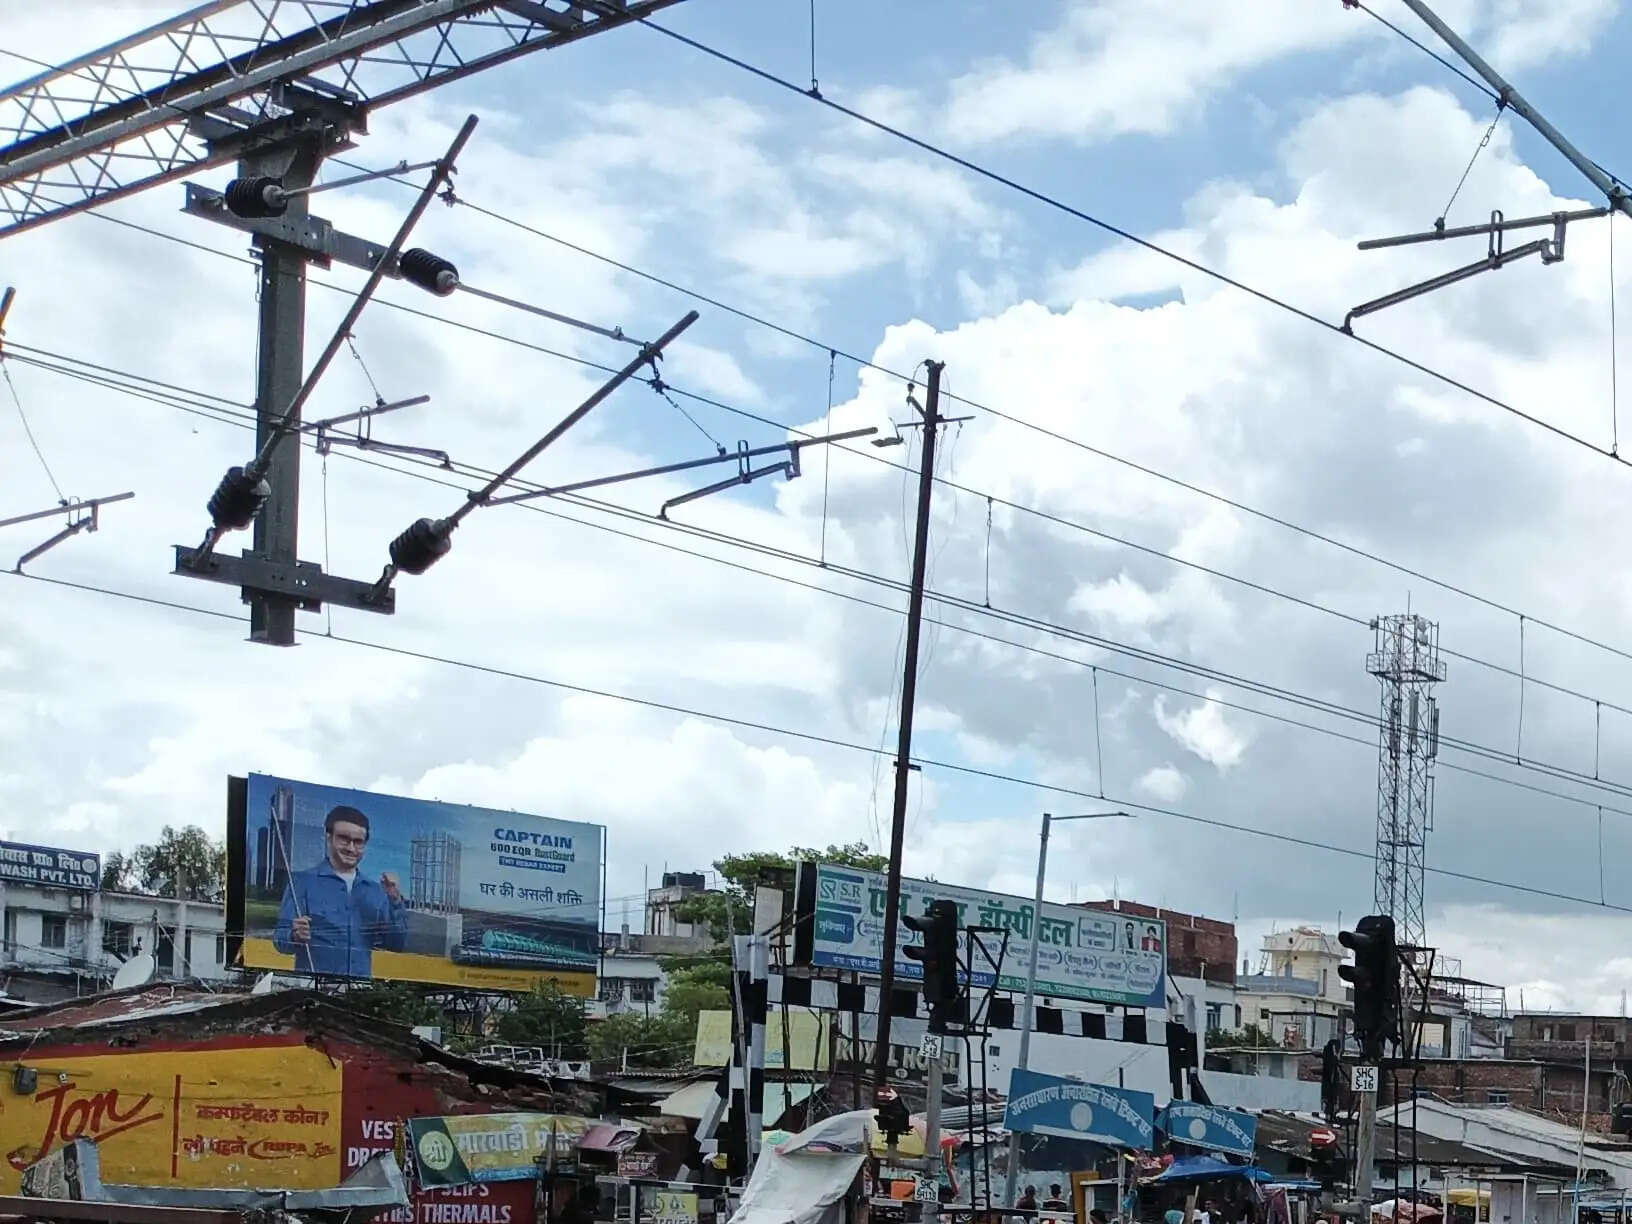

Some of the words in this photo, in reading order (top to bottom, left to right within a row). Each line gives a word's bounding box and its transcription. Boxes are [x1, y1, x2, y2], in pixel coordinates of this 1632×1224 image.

[494, 828, 572, 849] CAPTAIN
[40, 870, 66, 883] PVT.
[69, 873, 96, 887] LTD.
[480, 882, 496, 897] घर
[500, 881, 514, 899] की
[517, 886, 553, 904] असली
[1356, 1067, 1373, 1079] SHC
[1356, 1080, 1373, 1089] S-16
[423, 1204, 512, 1224] THERMALS
